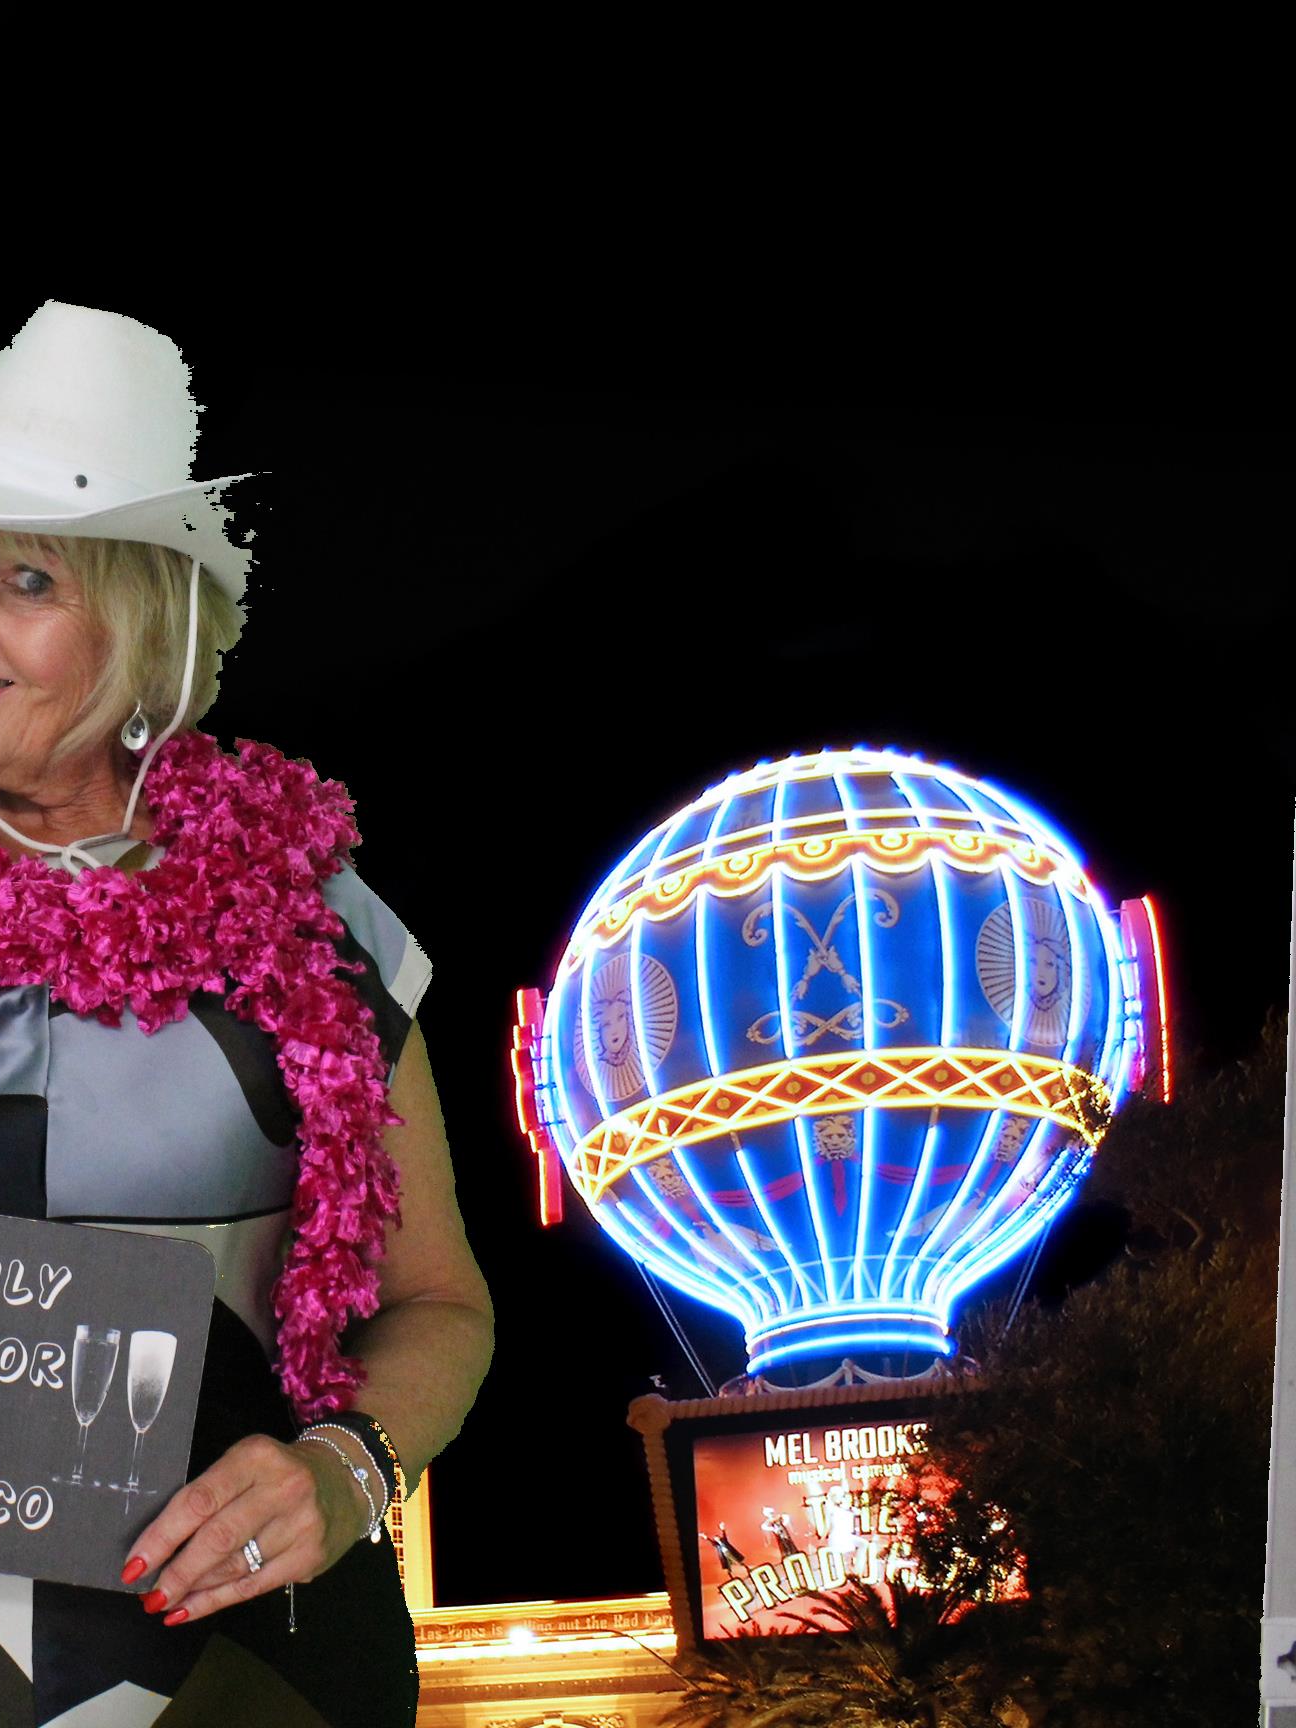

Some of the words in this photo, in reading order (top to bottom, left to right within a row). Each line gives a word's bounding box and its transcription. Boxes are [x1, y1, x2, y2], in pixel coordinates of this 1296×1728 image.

[764, 1432, 819, 1467] MEL
[420, 1626, 443, 1641] Las
[491, 1623, 504, 1636] is
[586, 1615, 608, 1630] the
